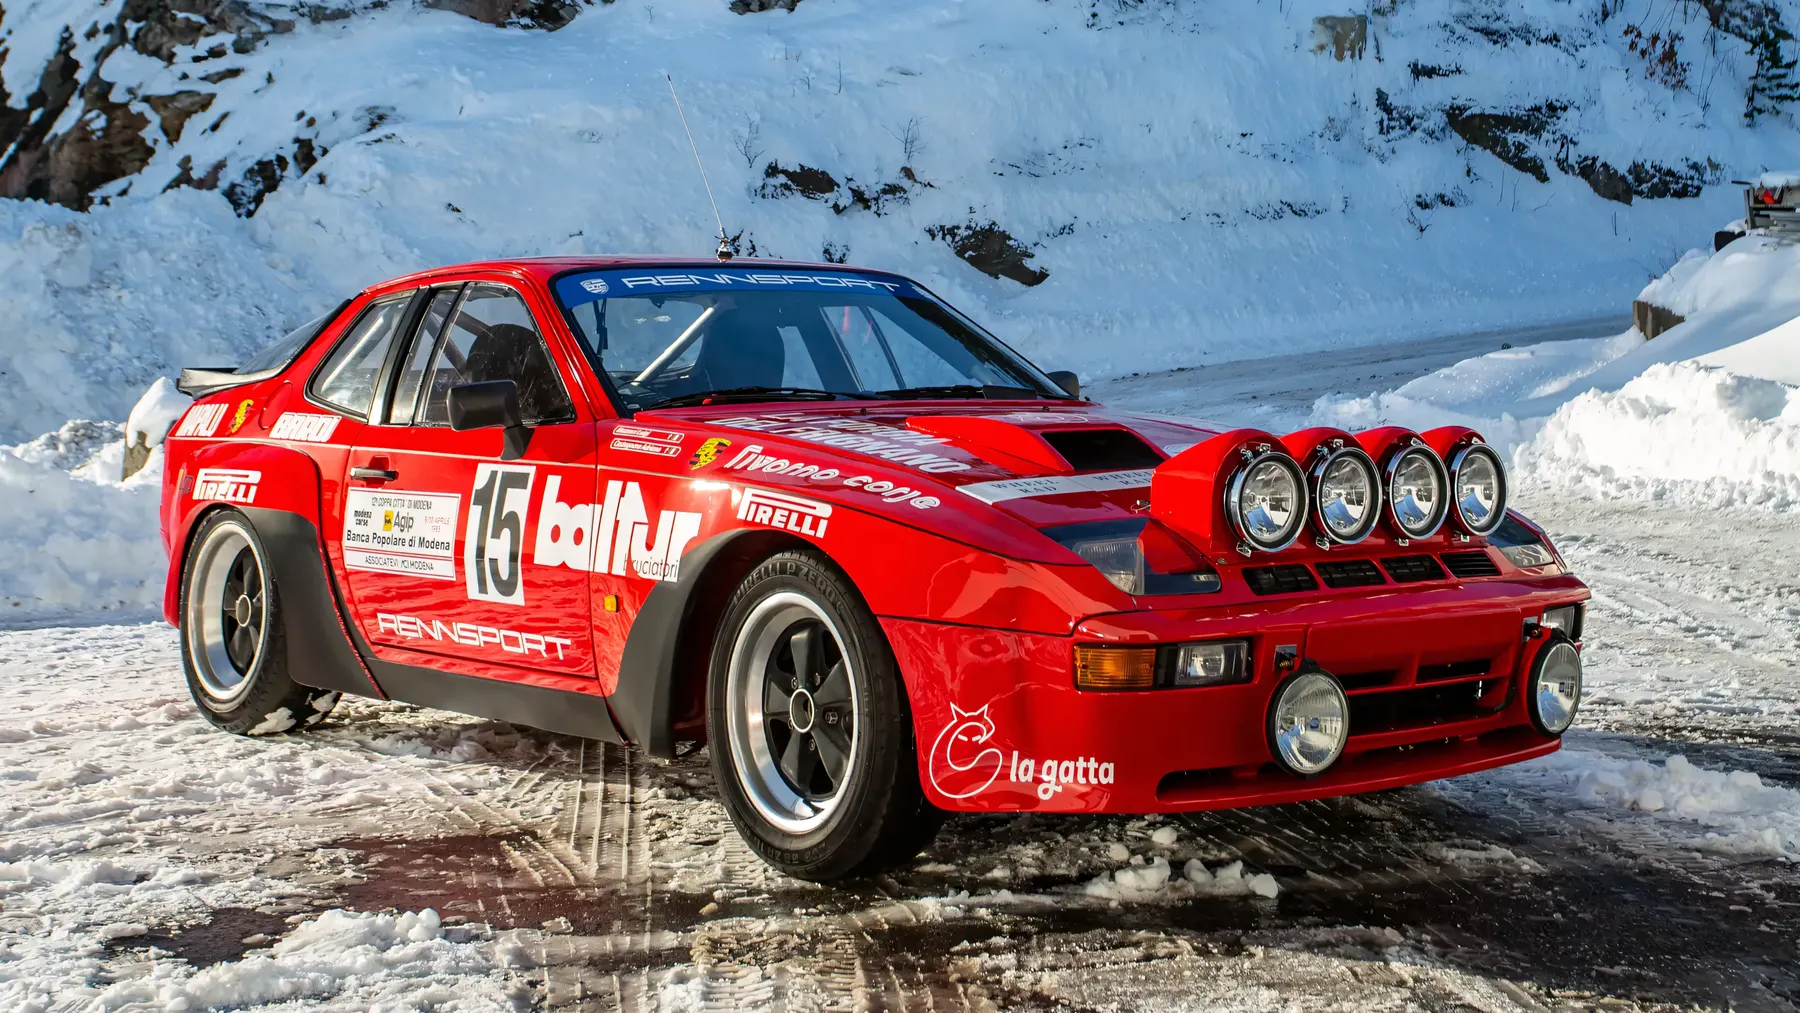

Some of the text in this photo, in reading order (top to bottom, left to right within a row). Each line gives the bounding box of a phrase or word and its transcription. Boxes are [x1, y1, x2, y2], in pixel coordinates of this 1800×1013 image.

[621, 274, 900, 292] RENNSPORT
[704, 416, 972, 473] DEL FRIGNANO
[192, 468, 262, 503] PIRELLI
[991, 479, 1059, 489] WHEEL
[1018, 486, 1057, 494] RAD
[353, 508, 372, 519] modena
[355, 518, 369, 527] corse
[393, 511, 415, 533] Agip
[737, 488, 832, 539] PIRELLI
[472, 469, 530, 598] 15
[533, 474, 702, 583] baltur
[346, 529, 451, 551] Banca Popolare di Modena
[410, 560, 434, 571] MODENA
[377, 612, 572, 660] RENNSPORT
[1009, 750, 1115, 801] la gatta
